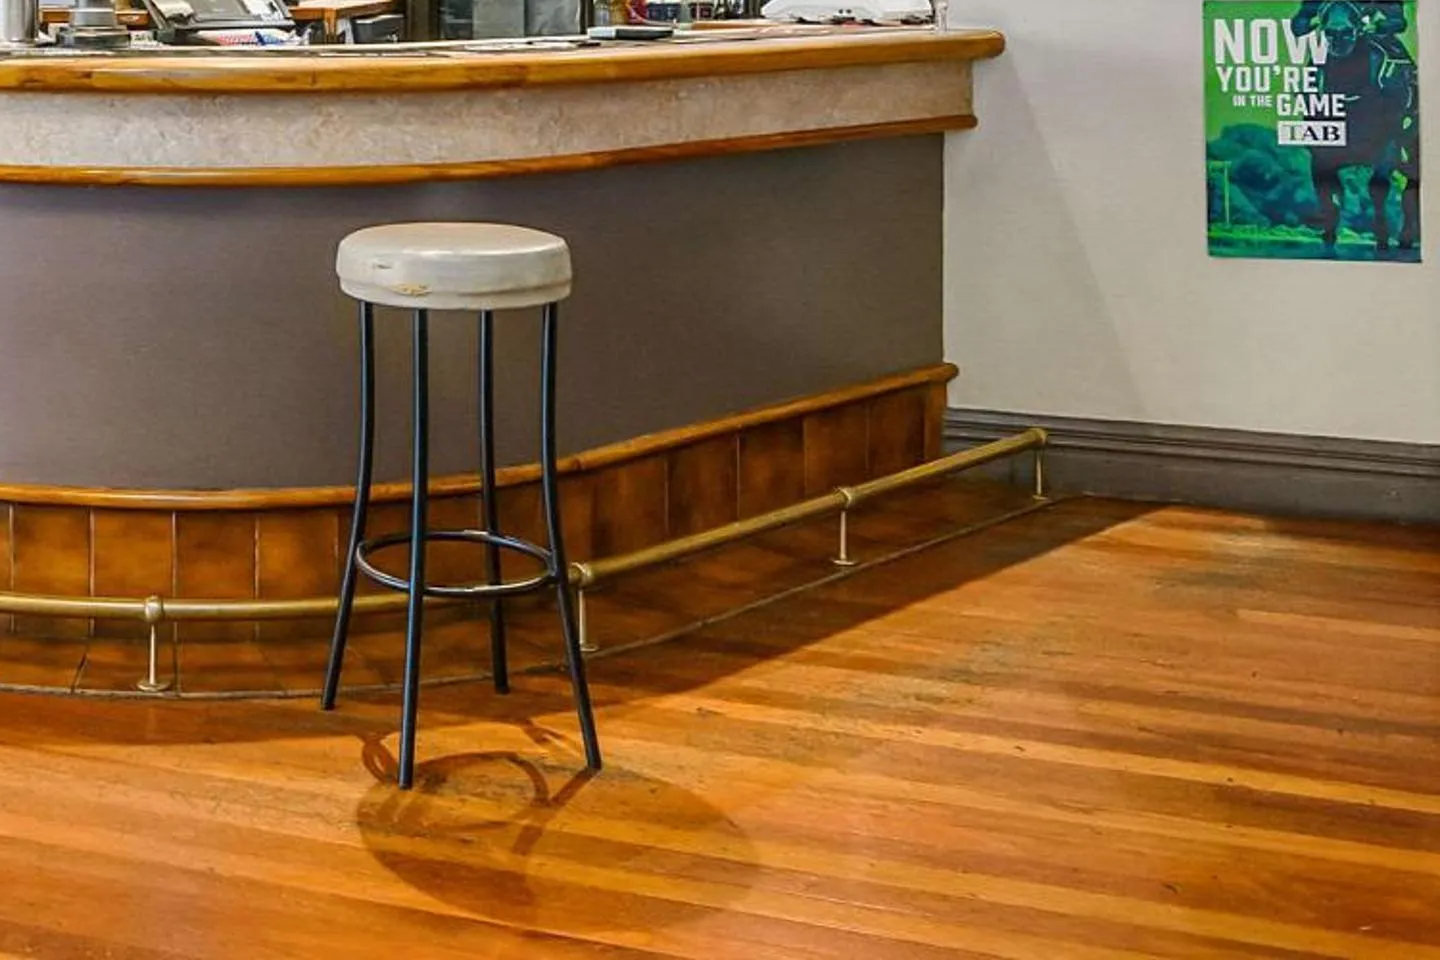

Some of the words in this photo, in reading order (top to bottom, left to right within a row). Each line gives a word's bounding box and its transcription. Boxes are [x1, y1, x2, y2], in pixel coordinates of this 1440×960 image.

[1214, 18, 1329, 65] NOW
[1216, 66, 1319, 93] YOU'RE
[1232, 95, 1247, 107] IN
[1251, 95, 1273, 107] THE
[1276, 93, 1347, 117] GAME
[1286, 124, 1342, 142] TAB
